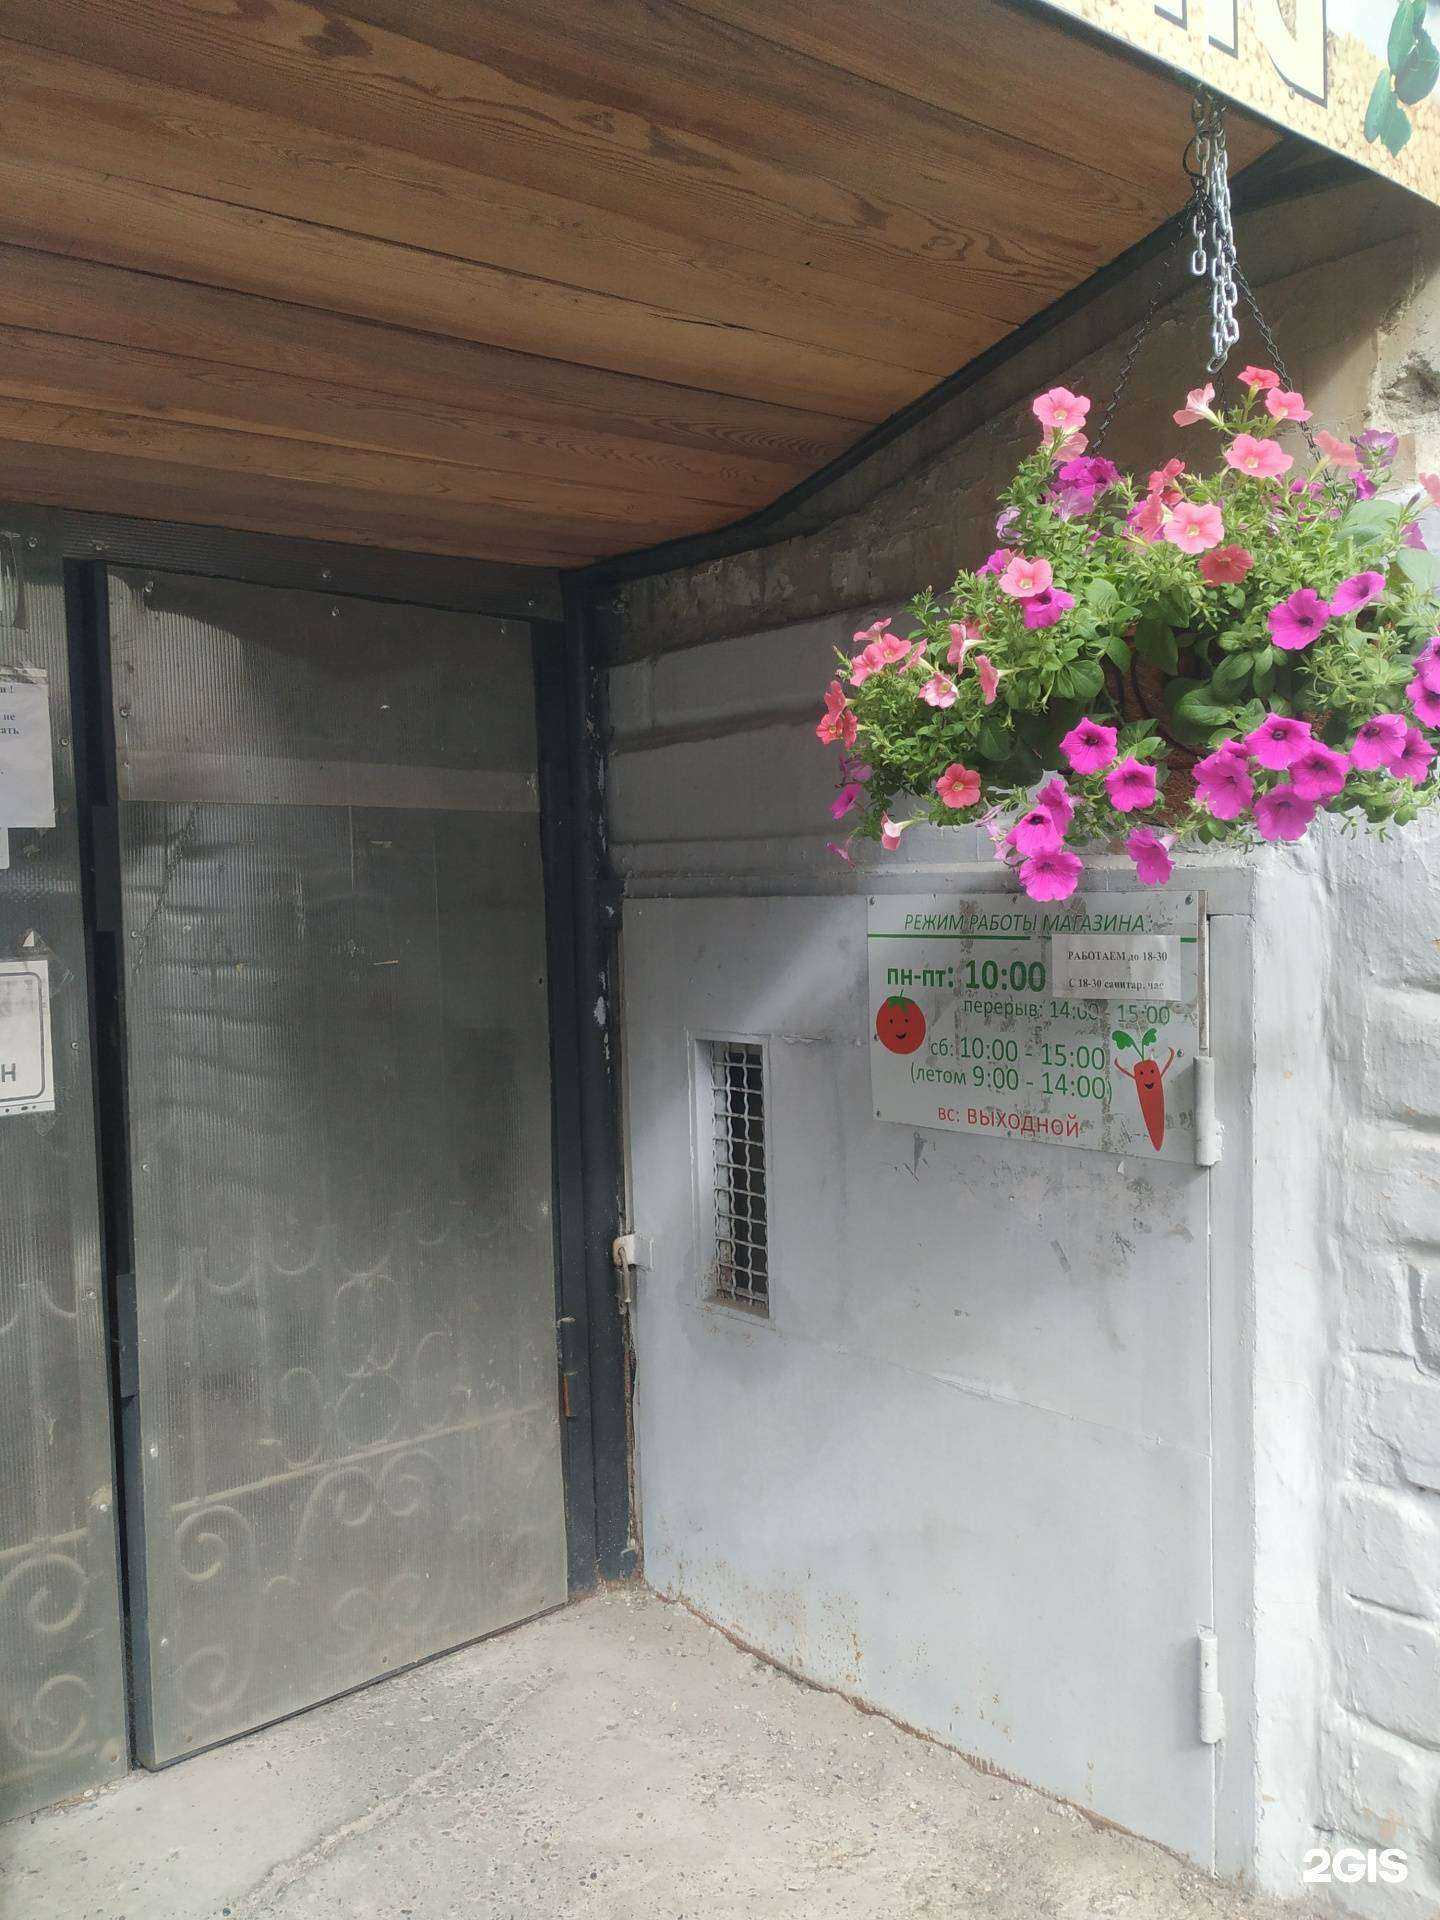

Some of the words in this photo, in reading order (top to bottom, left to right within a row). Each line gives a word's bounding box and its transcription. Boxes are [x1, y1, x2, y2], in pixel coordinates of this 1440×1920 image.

[904, 913, 965, 931] РЕЖИМ
[970, 914, 1037, 931] РАБОТЫ
[1067, 950, 1125, 962] РАБОТАЕМ
[1128, 954, 1139, 963] до
[1143, 951, 1168, 962] 18-30
[887, 966, 954, 989] пн-пт:
[965, 959, 1046, 993] 10:00
[1078, 978, 1102, 989] 18-30
[964, 1000, 1042, 1018] перерыв:
[1117, 1003, 1170, 1026] 15:00
[930, 1038, 954, 1057] сб:
[960, 1036, 1018, 1062] 10:00
[1041, 1042, 1105, 1070] 15:00
[910, 1061, 966, 1086] (летом
[972, 1065, 1019, 1091] 9:00
[1042, 1072, 1112, 1104] 14:00)
[938, 1106, 960, 1123] вс:
[967, 1107, 1080, 1138] ВЫХОДНОЙ
